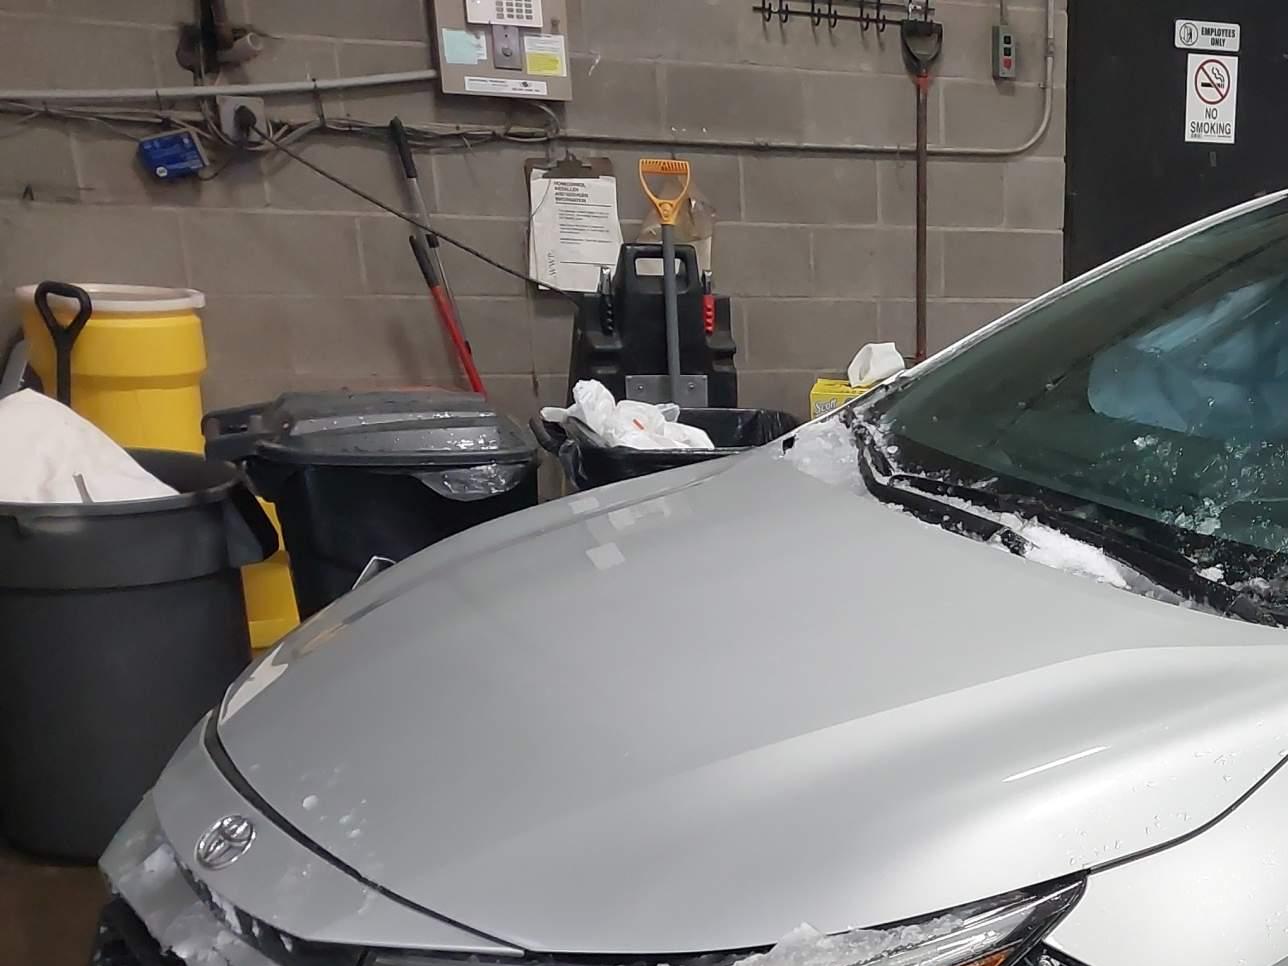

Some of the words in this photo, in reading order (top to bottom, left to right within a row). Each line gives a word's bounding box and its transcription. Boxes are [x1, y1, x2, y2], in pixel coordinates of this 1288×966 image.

[1201, 27, 1236, 38] EMPLOYEES
[1210, 37, 1226, 47] ONLY
[1205, 107, 1218, 120] NO
[1190, 121, 1231, 135] SMOKING
